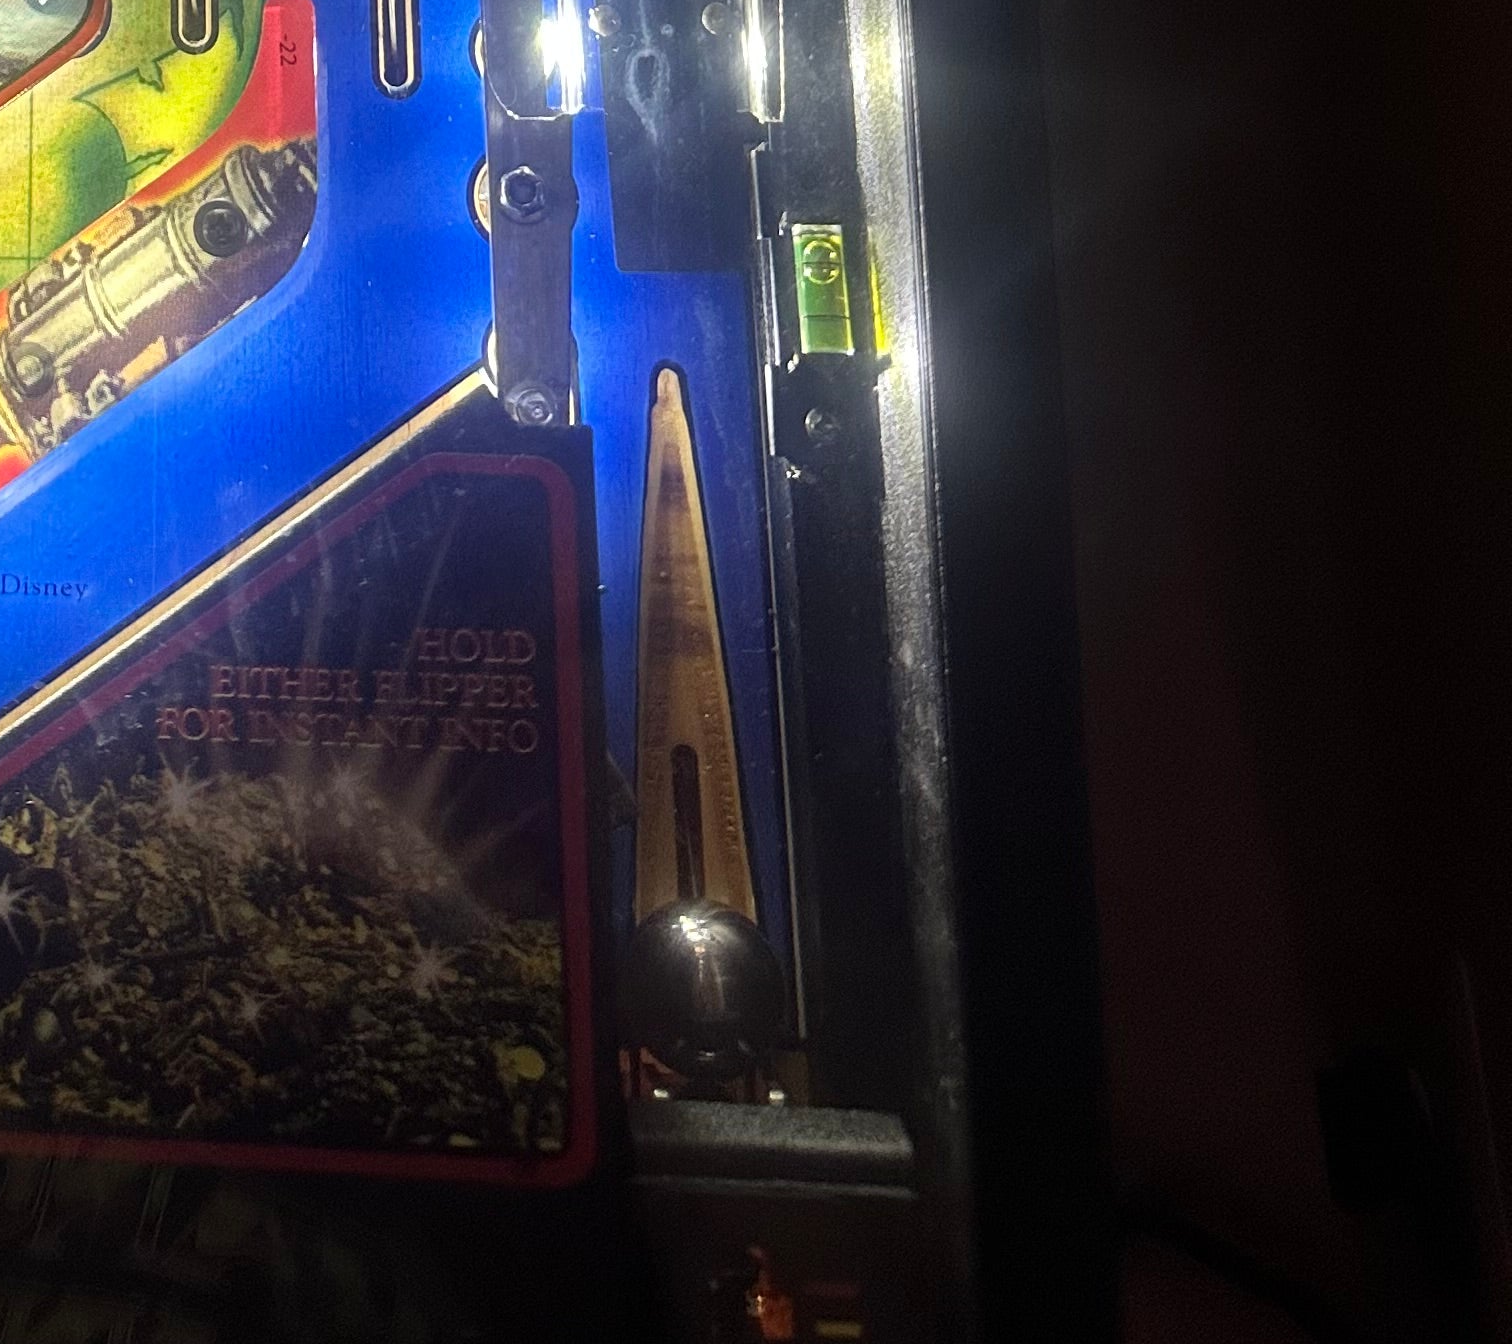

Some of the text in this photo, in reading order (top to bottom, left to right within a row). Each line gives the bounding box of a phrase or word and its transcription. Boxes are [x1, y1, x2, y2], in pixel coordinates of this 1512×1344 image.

[418, 628, 537, 666] HOLD
[211, 664, 540, 711] EITHER FLIPPER
[157, 707, 540, 754] FOR INSTANT INFO
